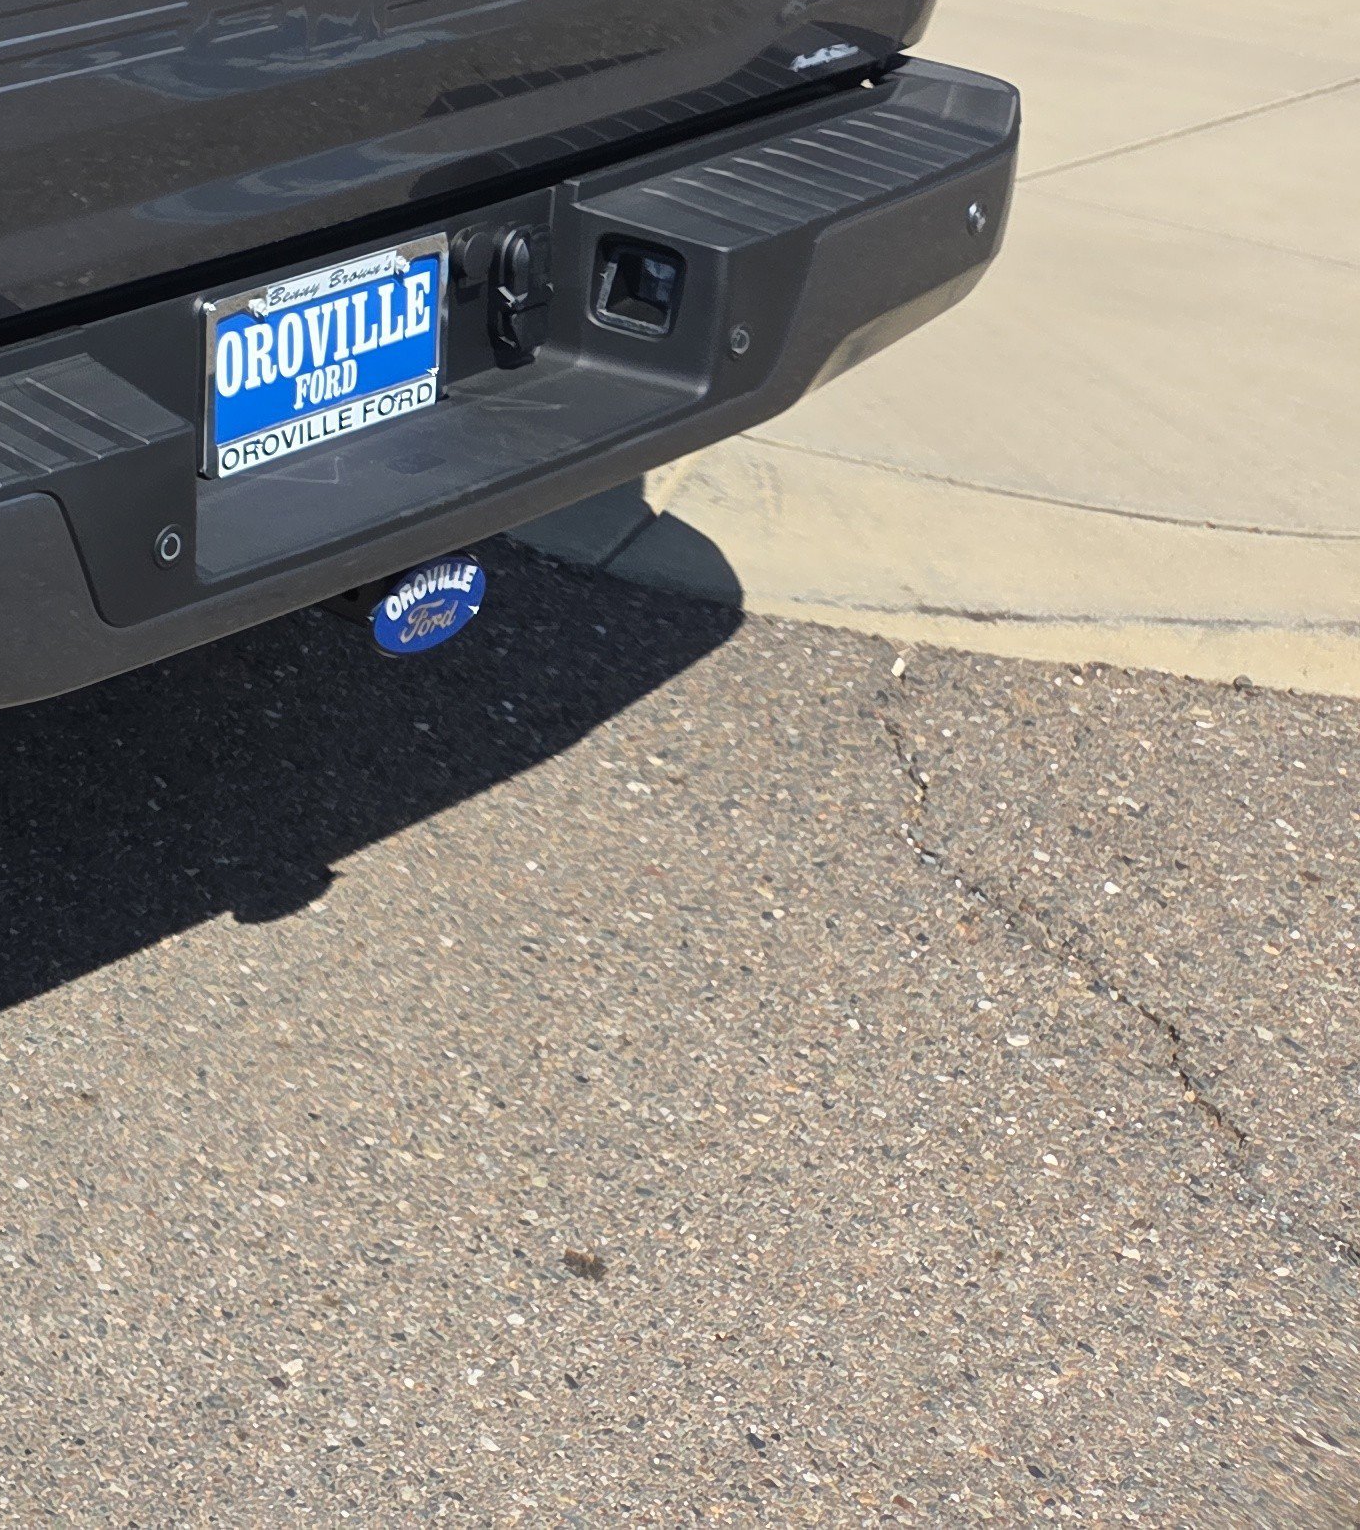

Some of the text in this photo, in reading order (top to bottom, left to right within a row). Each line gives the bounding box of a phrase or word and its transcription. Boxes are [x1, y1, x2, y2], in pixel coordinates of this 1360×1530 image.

[269, 252, 396, 307] Benny Brown's
[216, 272, 431, 398] OROVILLE
[293, 359, 358, 411] FORD
[221, 382, 434, 471] OROVILLE FORD
[385, 563, 478, 621] OROVILLE
[399, 598, 459, 644] Ford
